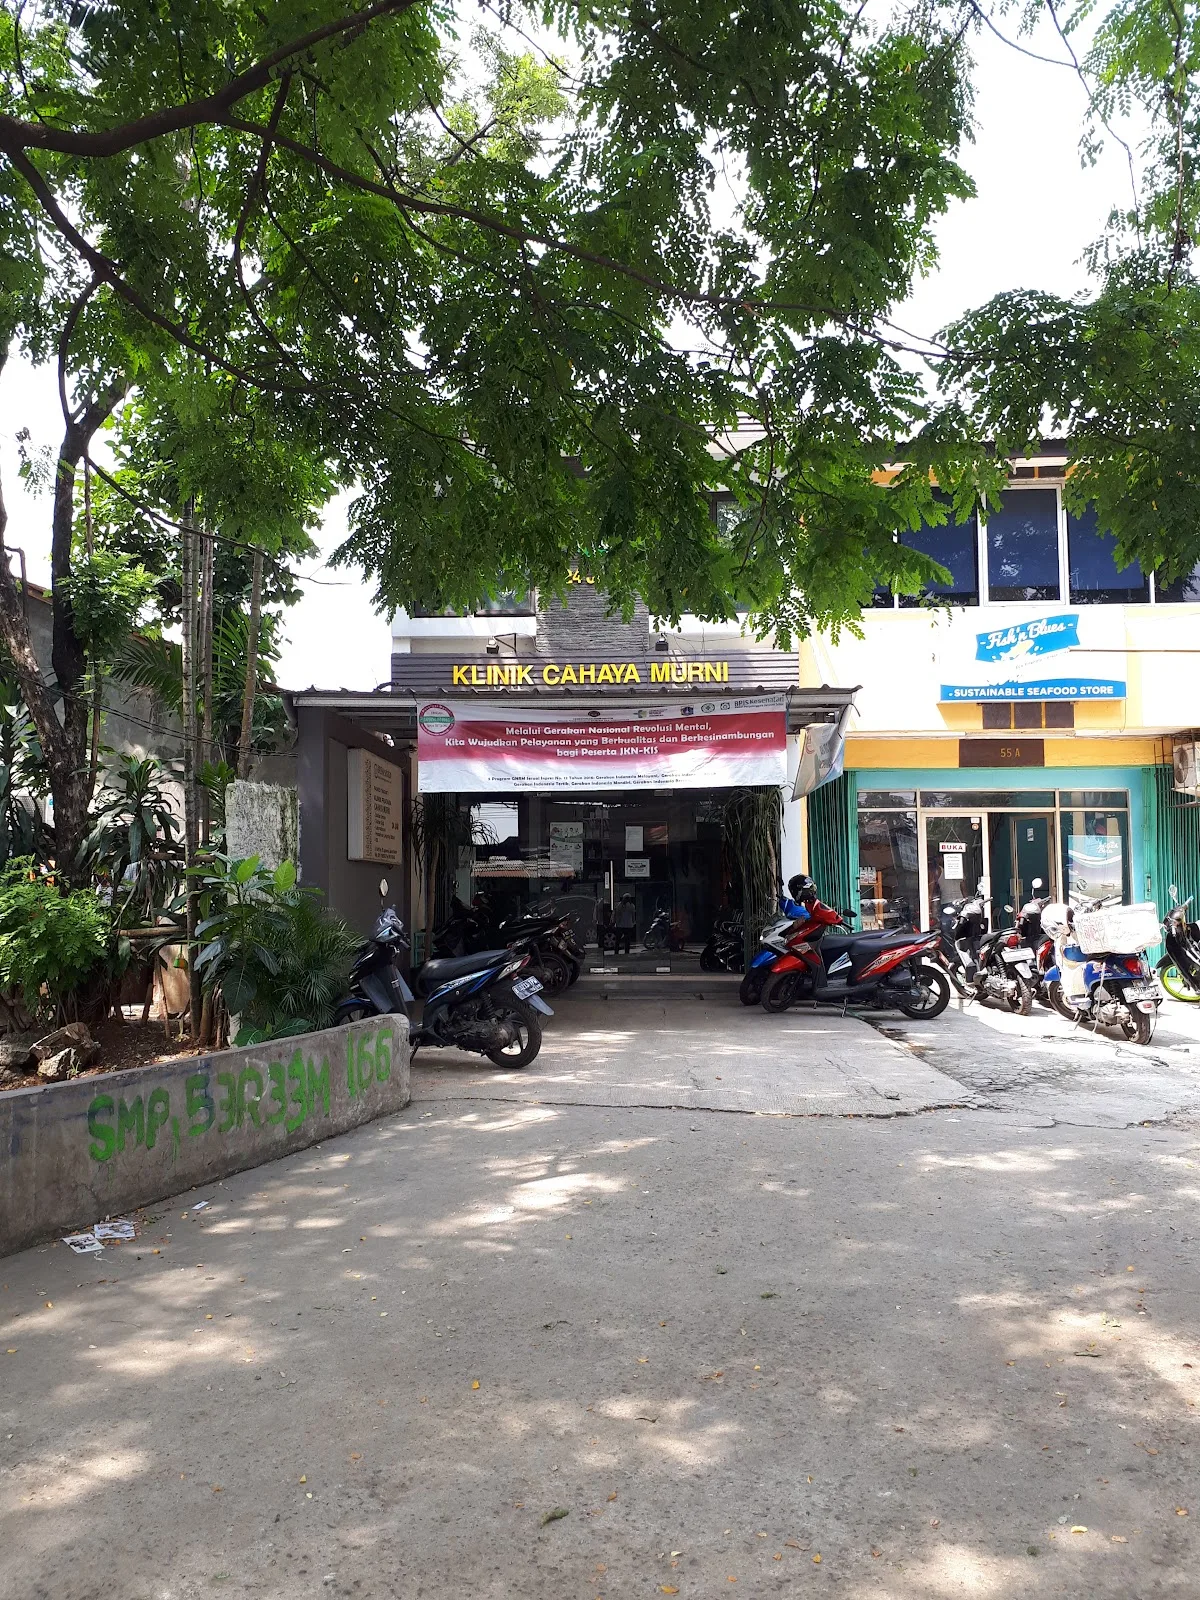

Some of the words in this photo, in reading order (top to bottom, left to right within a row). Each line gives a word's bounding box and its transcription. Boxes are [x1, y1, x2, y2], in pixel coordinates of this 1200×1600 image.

[1027, 619, 1066, 638] Blues
[452, 664, 534, 685] KLINIK
[543, 663, 641, 685] CAHAYA
[650, 661, 729, 683] MURNI
[954, 687, 1024, 697] SUSTAINABLE
[1027, 686, 1077, 696] SEAFOOD
[1080, 685, 1114, 695] STORE
[505, 726, 541, 735] Melalui
[543, 726, 585, 735] Gerakan
[588, 725, 630, 734] Nasional
[633, 723, 673, 733] Revolusi
[675, 722, 712, 732] Mental,
[444, 737, 465, 746] Kita
[467, 738, 517, 748] Wujudkan
[520, 738, 572, 748] Pelayanan
[574, 739, 598, 748] yang
[601, 736, 656, 745] Berkualitas
[659, 735, 678, 743] dan
[680, 731, 774, 743] Berkesinambungan
[556, 748, 579, 758] bagi
[581, 747, 616, 757] Peserta
[619, 746, 659, 756] JKN-KIS
[1001, 748, 1012, 758] 55
[1015, 747, 1021, 757] A
[346, 1028, 394, 1099] 166
